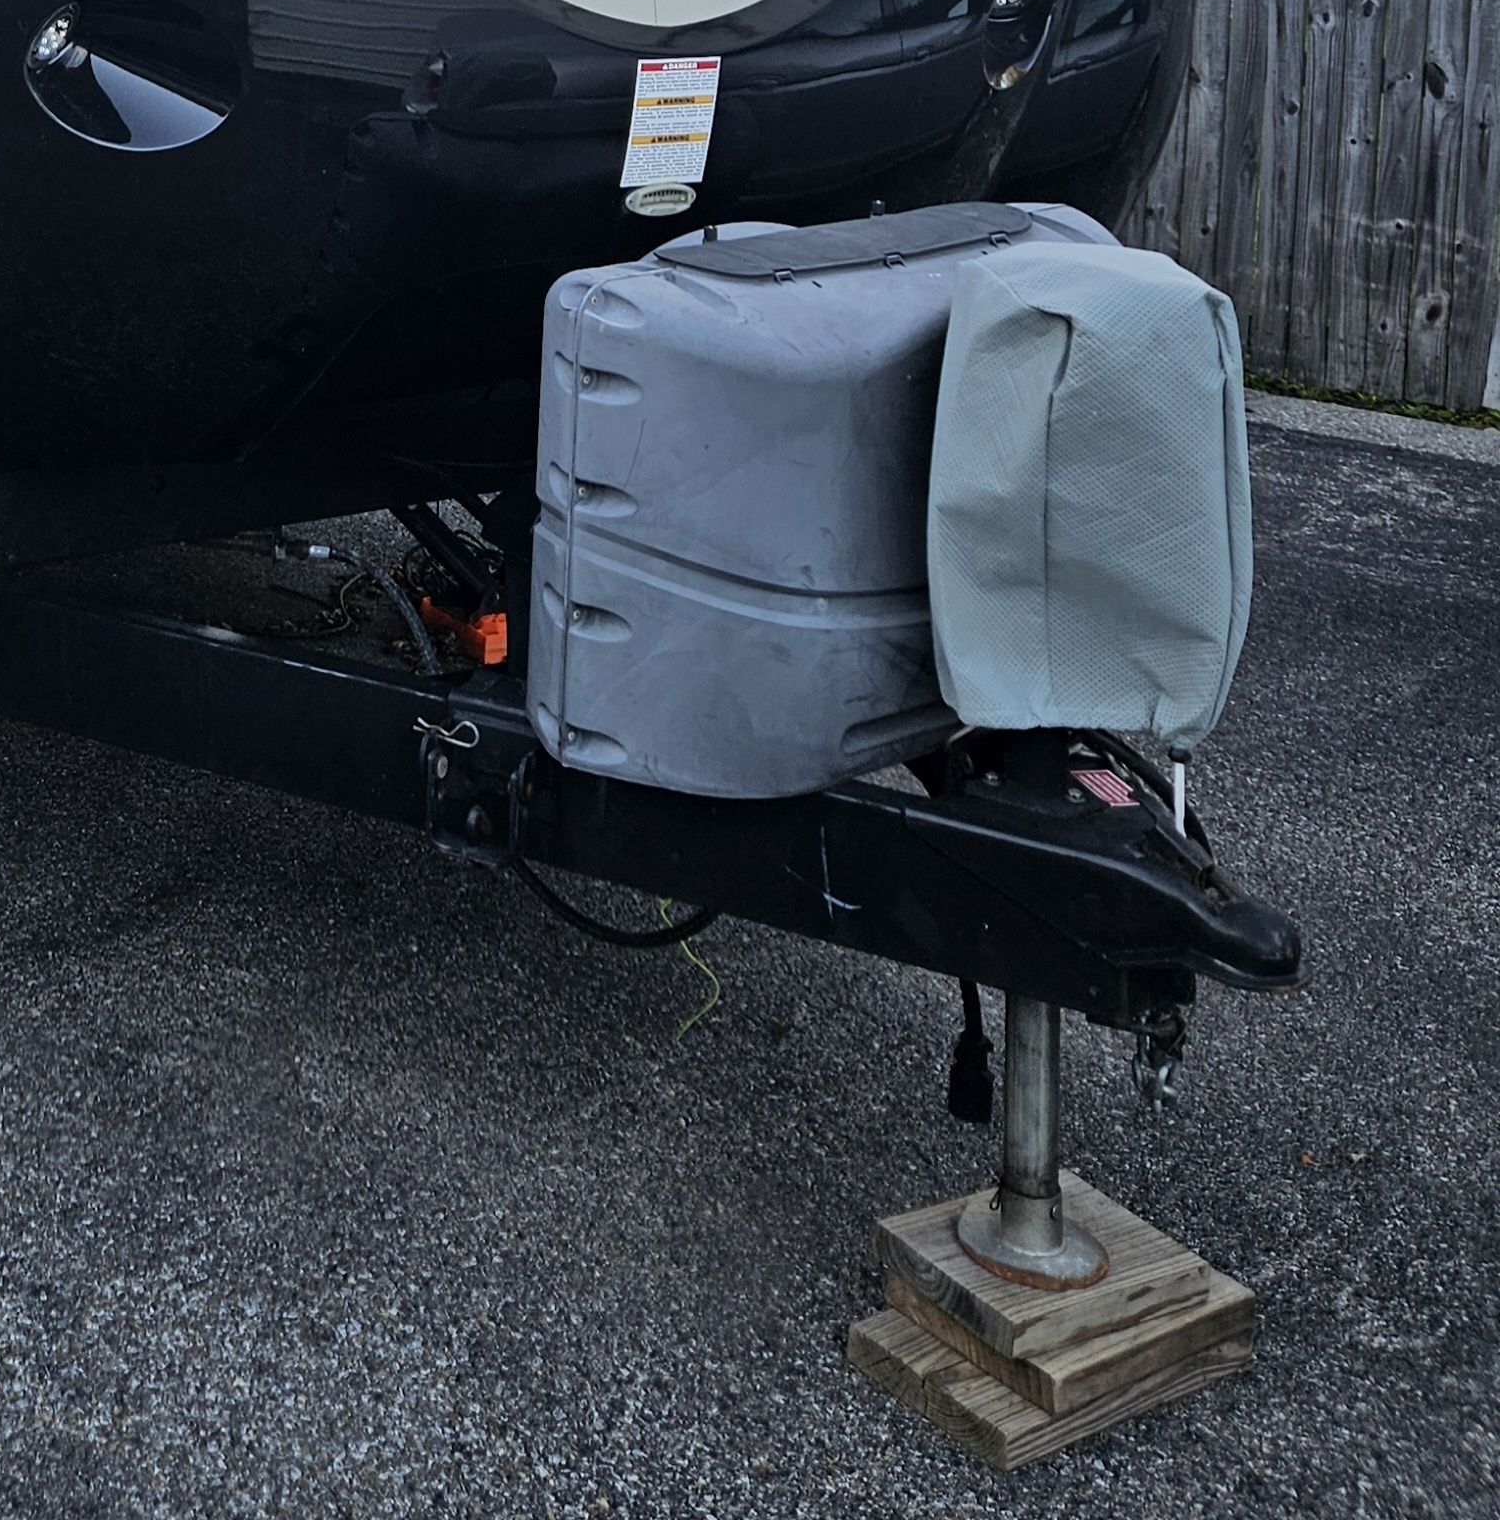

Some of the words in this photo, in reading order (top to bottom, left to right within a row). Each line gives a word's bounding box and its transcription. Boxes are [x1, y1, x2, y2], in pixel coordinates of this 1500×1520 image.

[668, 61, 698, 70] DANGER
[662, 96, 695, 105] WARNING
[657, 134, 690, 143] WARNING
